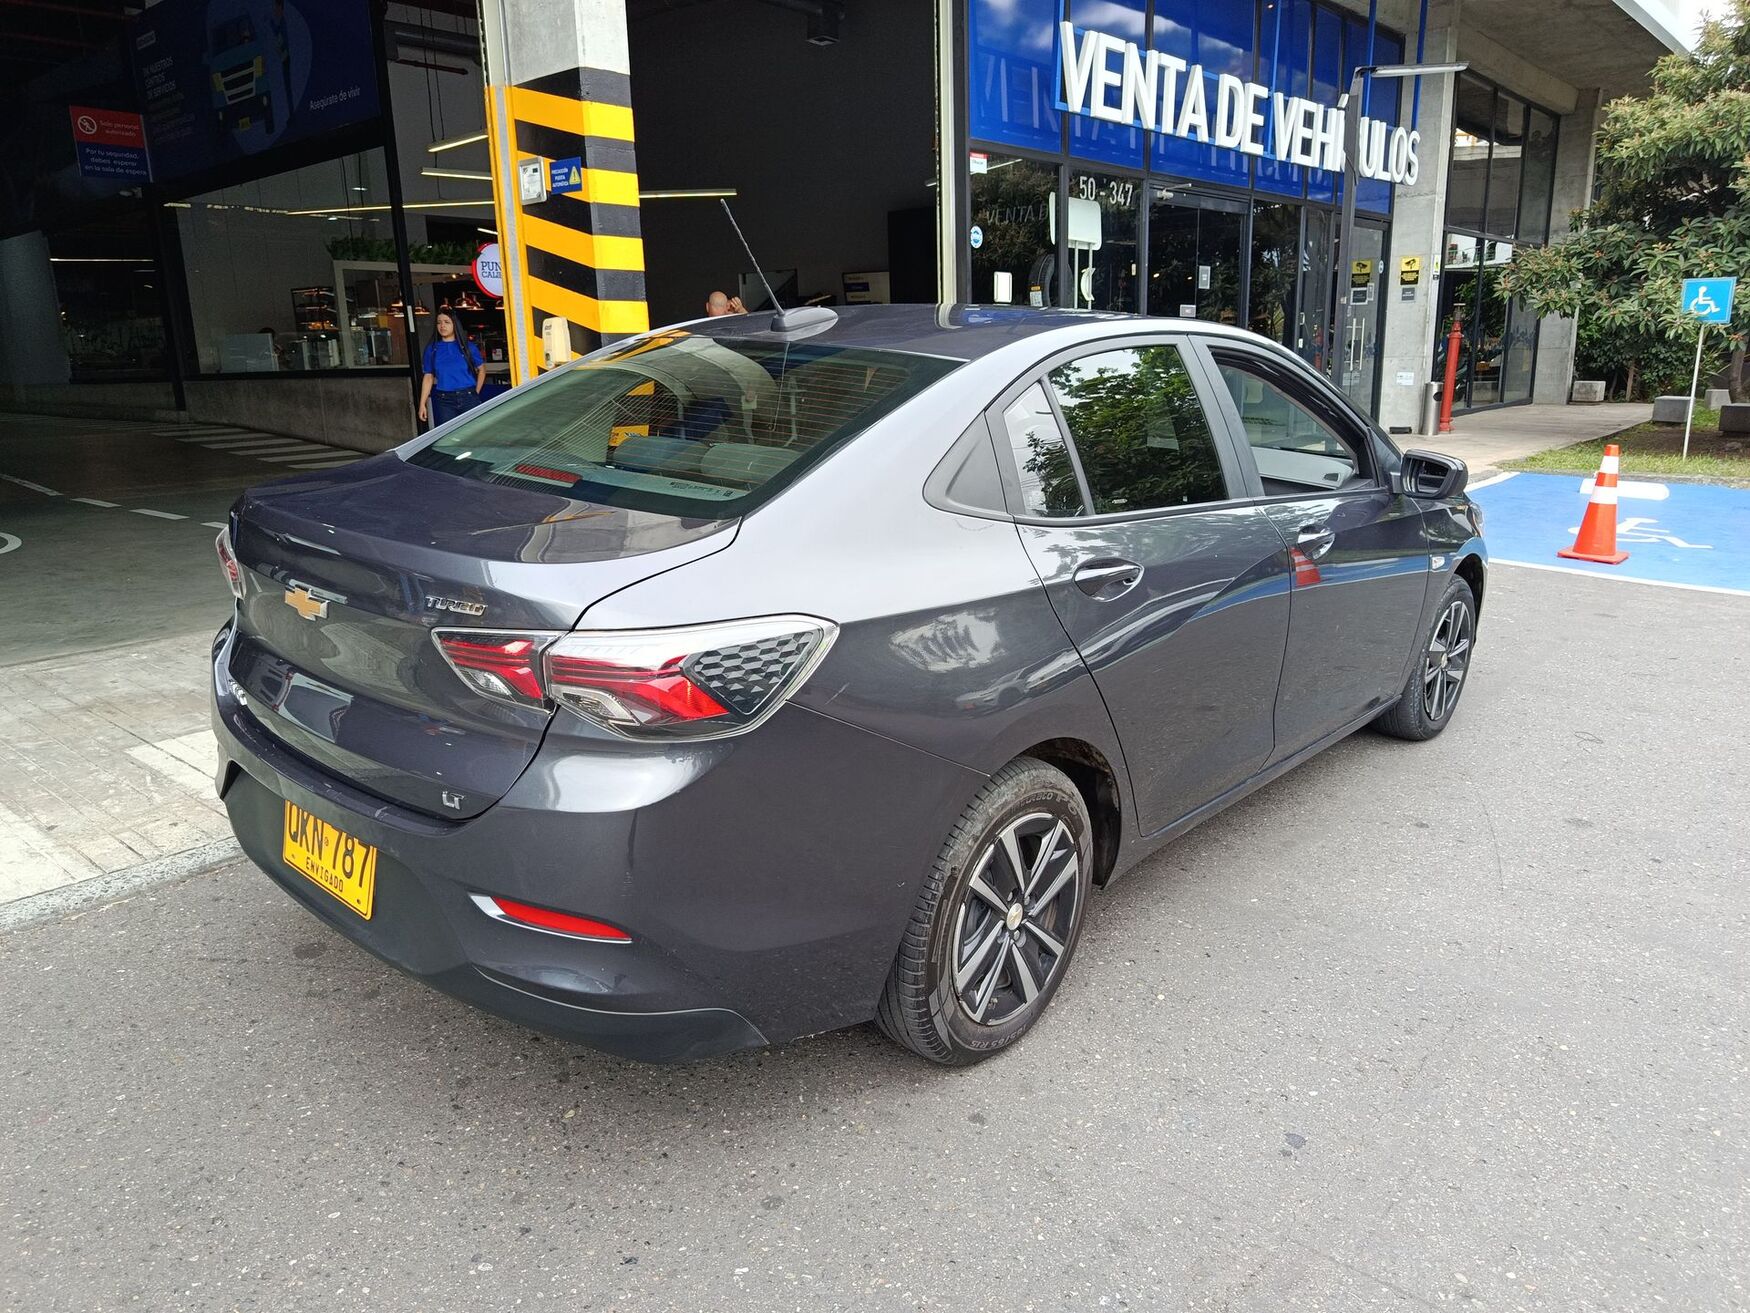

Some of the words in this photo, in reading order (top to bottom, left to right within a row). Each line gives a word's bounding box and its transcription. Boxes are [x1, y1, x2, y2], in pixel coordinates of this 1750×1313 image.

[1060, 20, 1209, 143] VENTA
[1215, 72, 1269, 156] DE
[1273, 92, 1421, 186] VEHÍULOS
[1079, 176, 1096, 200] 50
[1109, 181, 1133, 207] 347
[425, 595, 488, 616] TURBO
[441, 791, 465, 810] LT
[331, 825, 372, 889] 787
[305, 857, 344, 893] ENVIGADO
